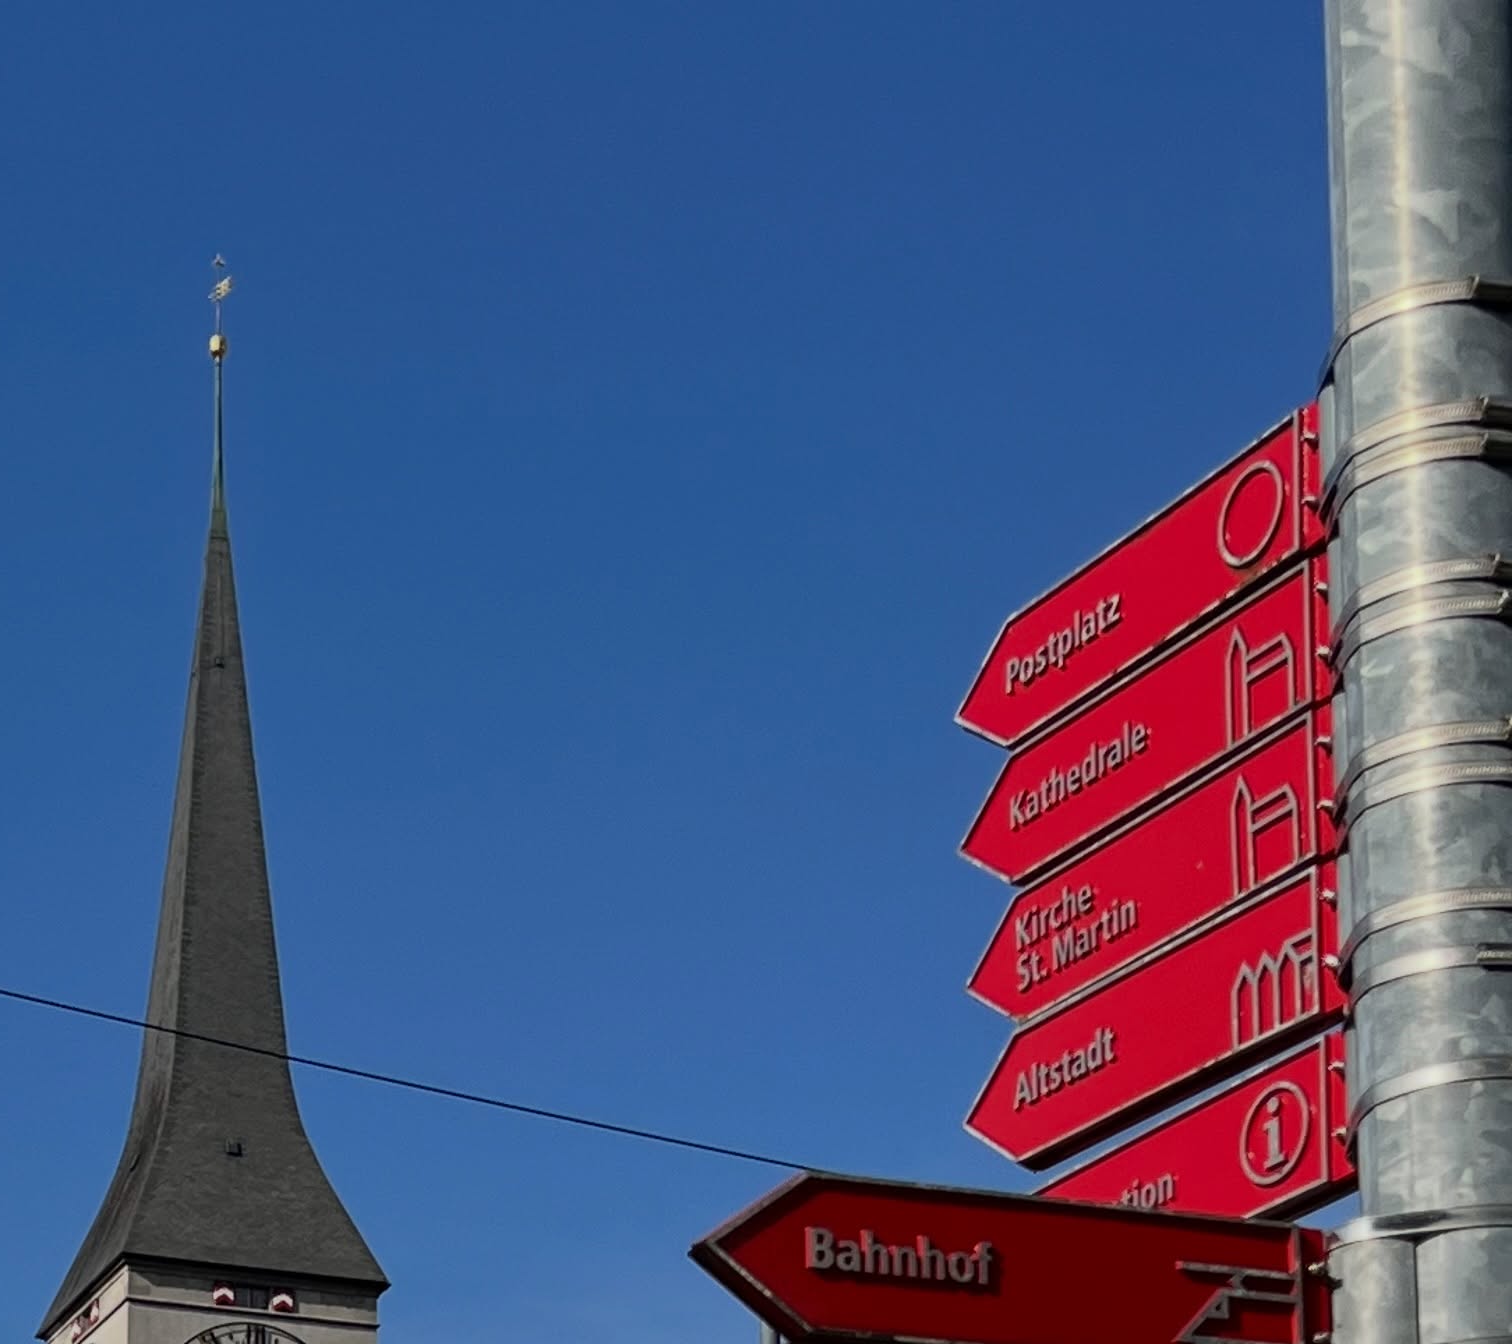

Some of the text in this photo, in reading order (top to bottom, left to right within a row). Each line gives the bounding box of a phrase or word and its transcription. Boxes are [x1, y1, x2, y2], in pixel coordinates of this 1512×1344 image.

[1005, 594, 1123, 694] Postplatz
[1009, 721, 1147, 830] Kathedrale
[1014, 883, 1093, 953] Kirche
[1017, 899, 1138, 993] St. Martin
[1013, 1027, 1116, 1111] Altstadt
[804, 1225, 996, 1286] Bahnhof
